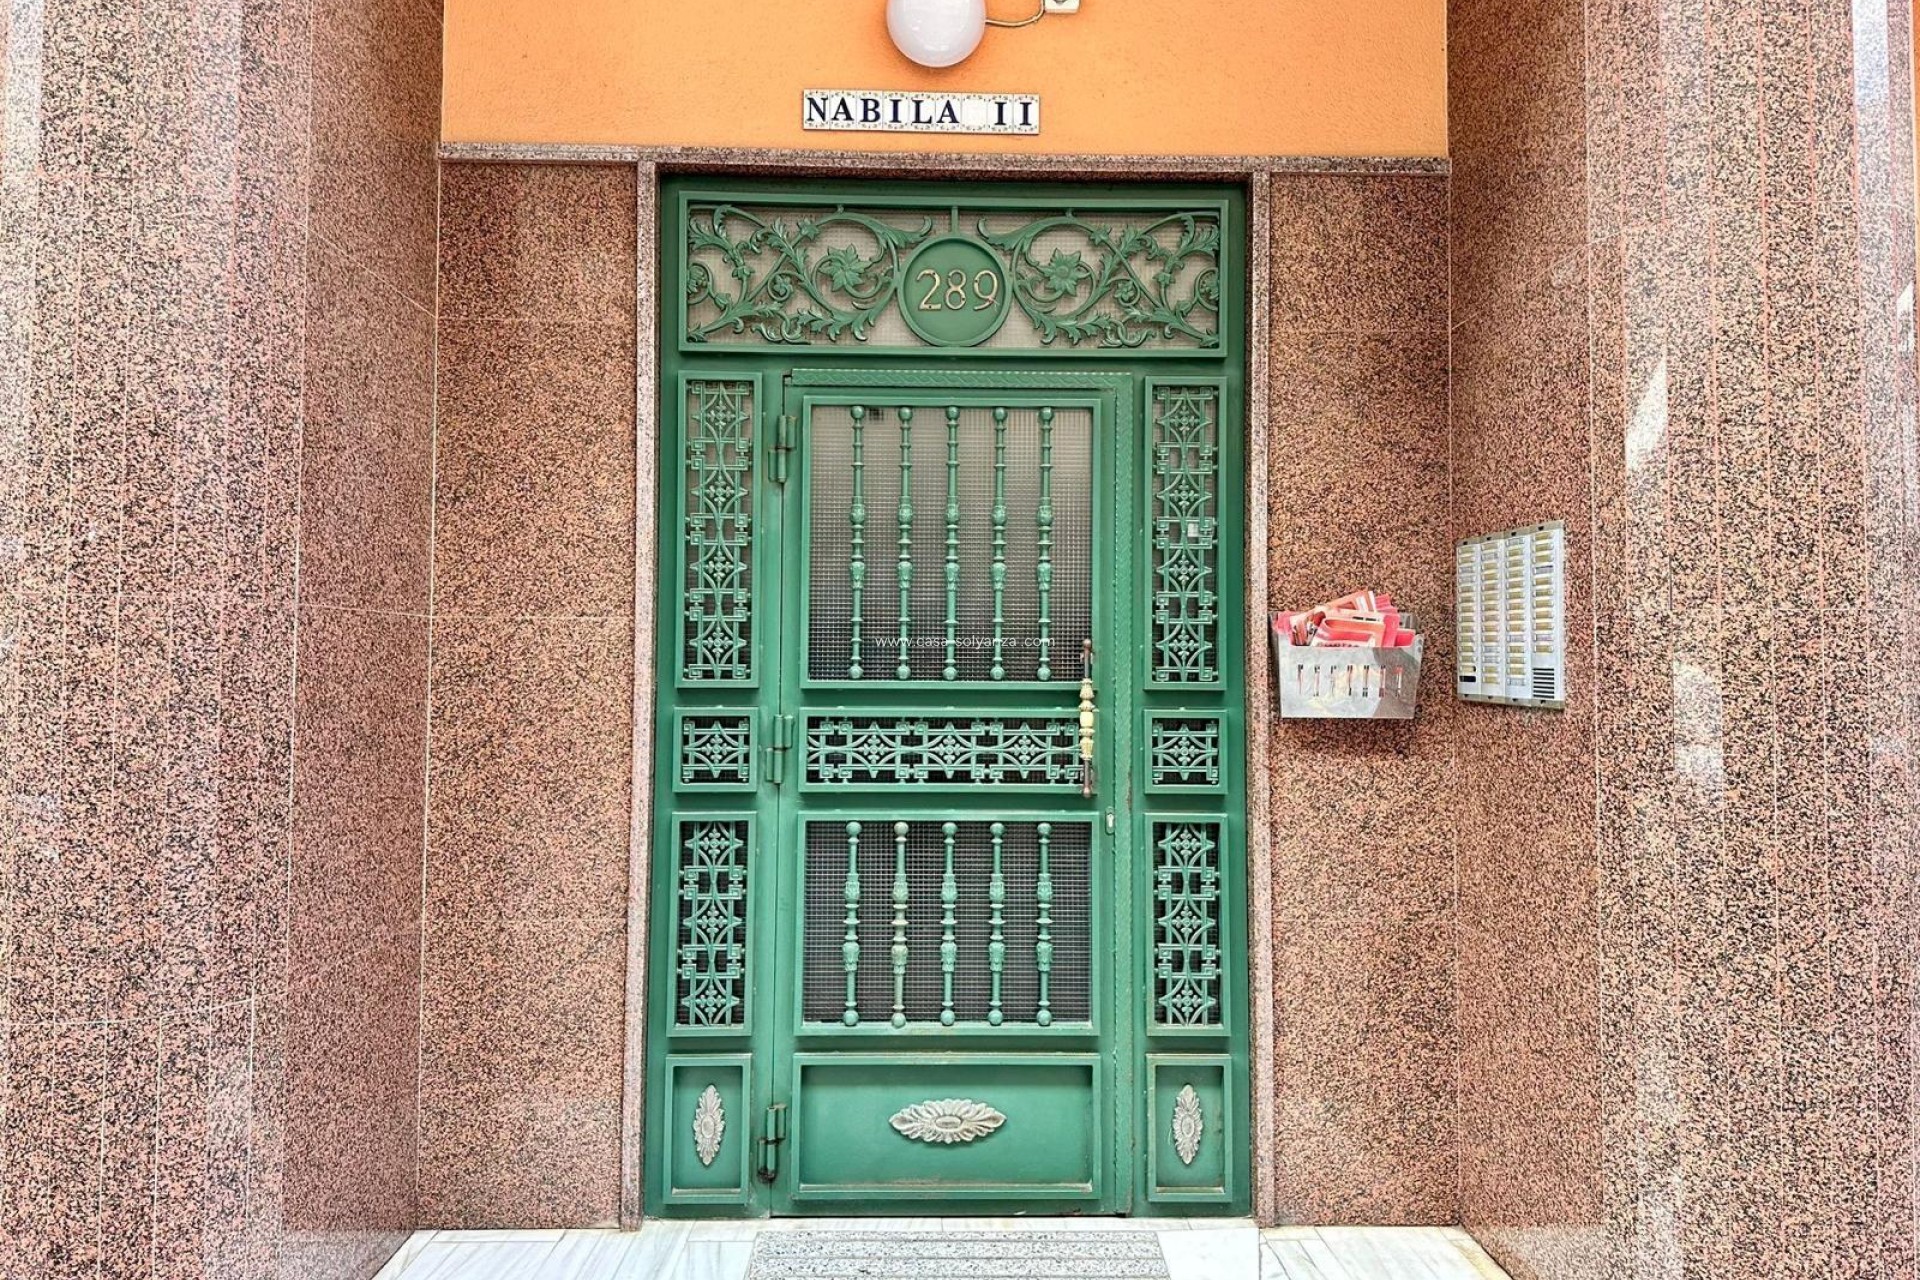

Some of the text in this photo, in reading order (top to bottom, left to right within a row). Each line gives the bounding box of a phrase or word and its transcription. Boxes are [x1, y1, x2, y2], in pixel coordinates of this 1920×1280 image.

[806, 97, 1033, 126] NABILA II
[916, 268, 998, 311] 289
